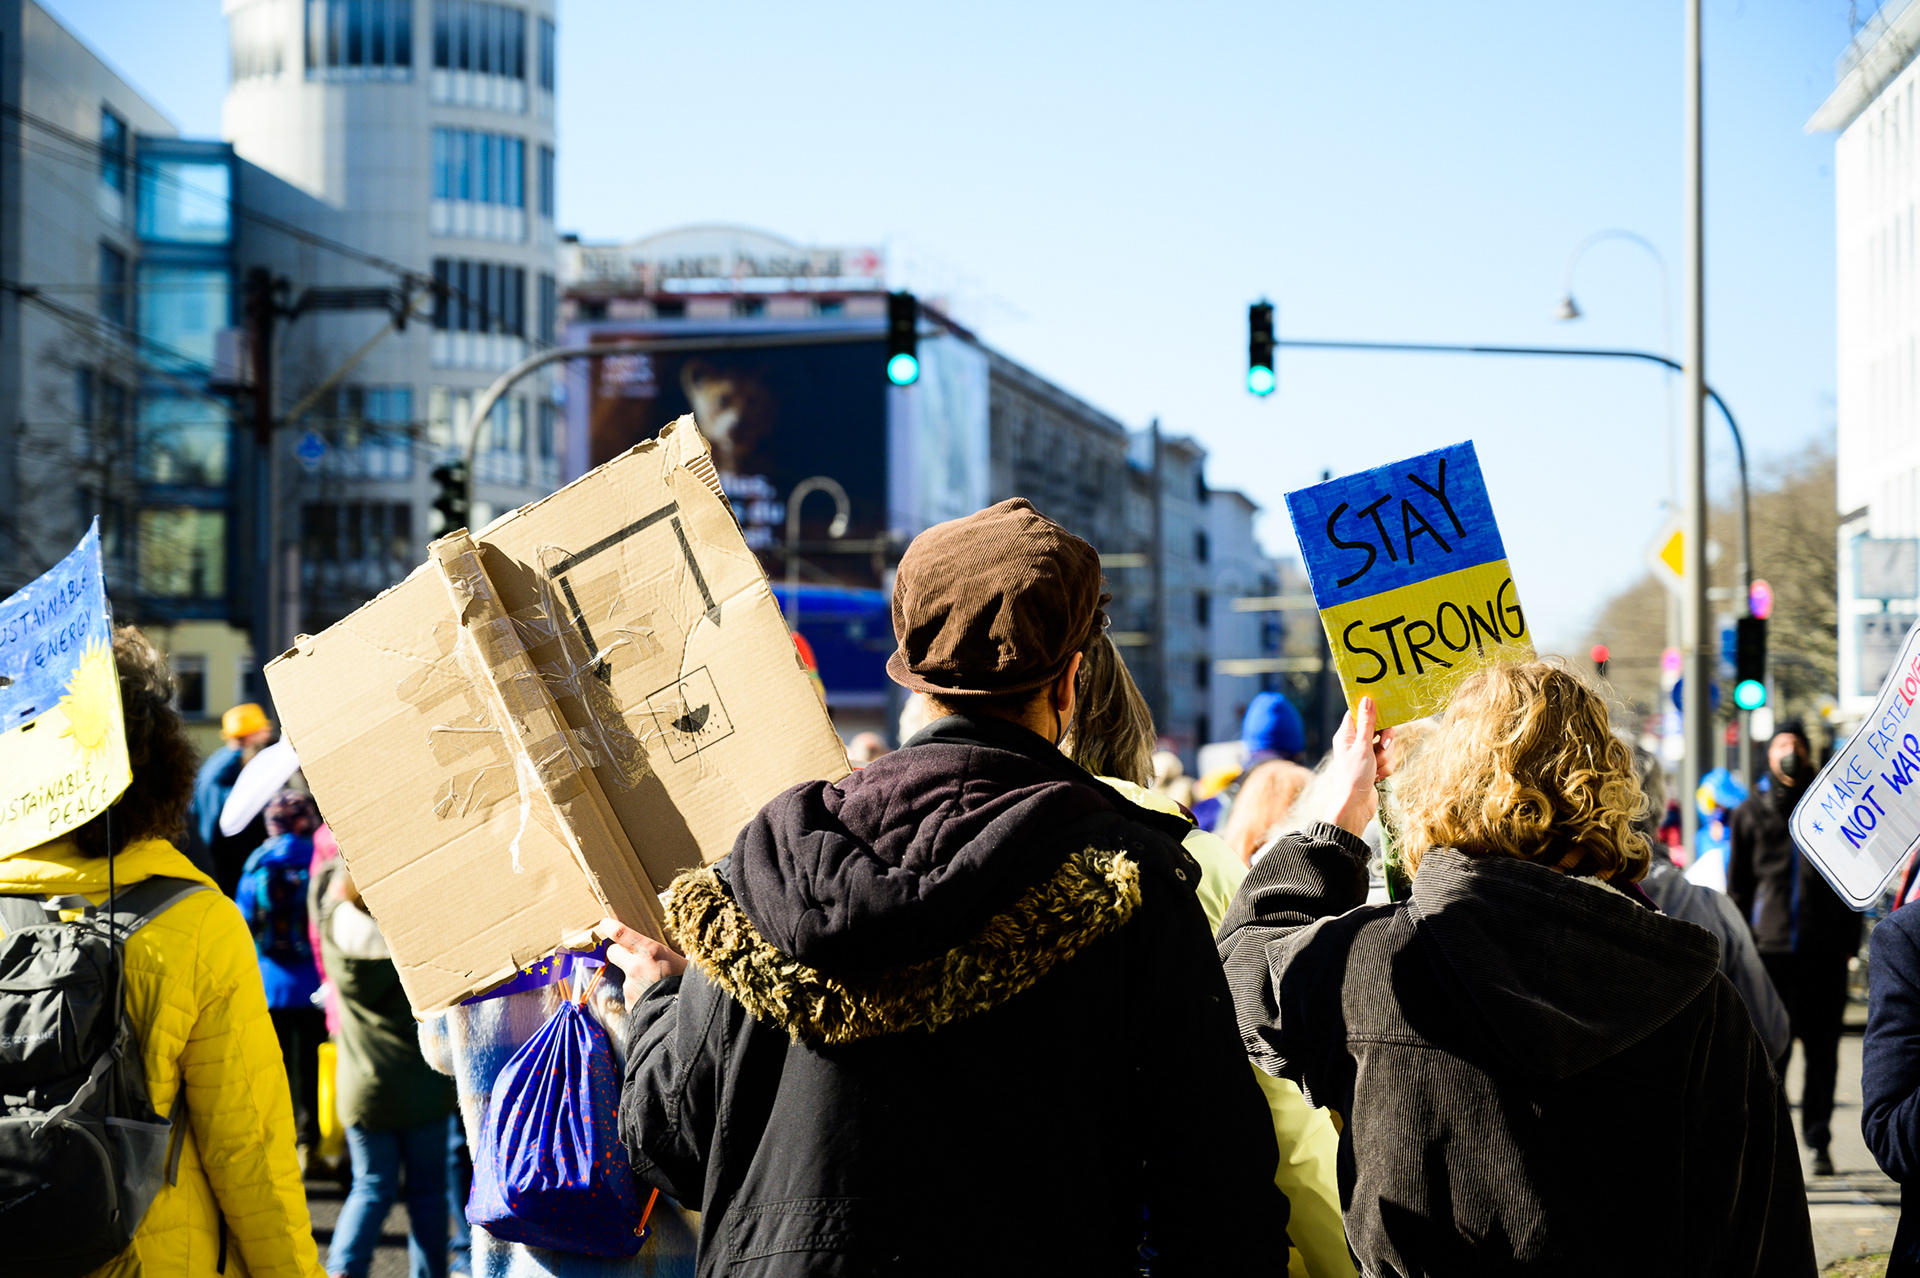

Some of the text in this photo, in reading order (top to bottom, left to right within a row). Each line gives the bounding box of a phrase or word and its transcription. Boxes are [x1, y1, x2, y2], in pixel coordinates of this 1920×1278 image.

[1326, 457, 1467, 588] STAY
[34, 603, 91, 669] ENERGY
[1342, 577, 1525, 684] STRONG
[48, 774, 110, 832] PEACE
[1820, 754, 1873, 821] MAKE
[1840, 733, 1920, 850] NOT WAR
